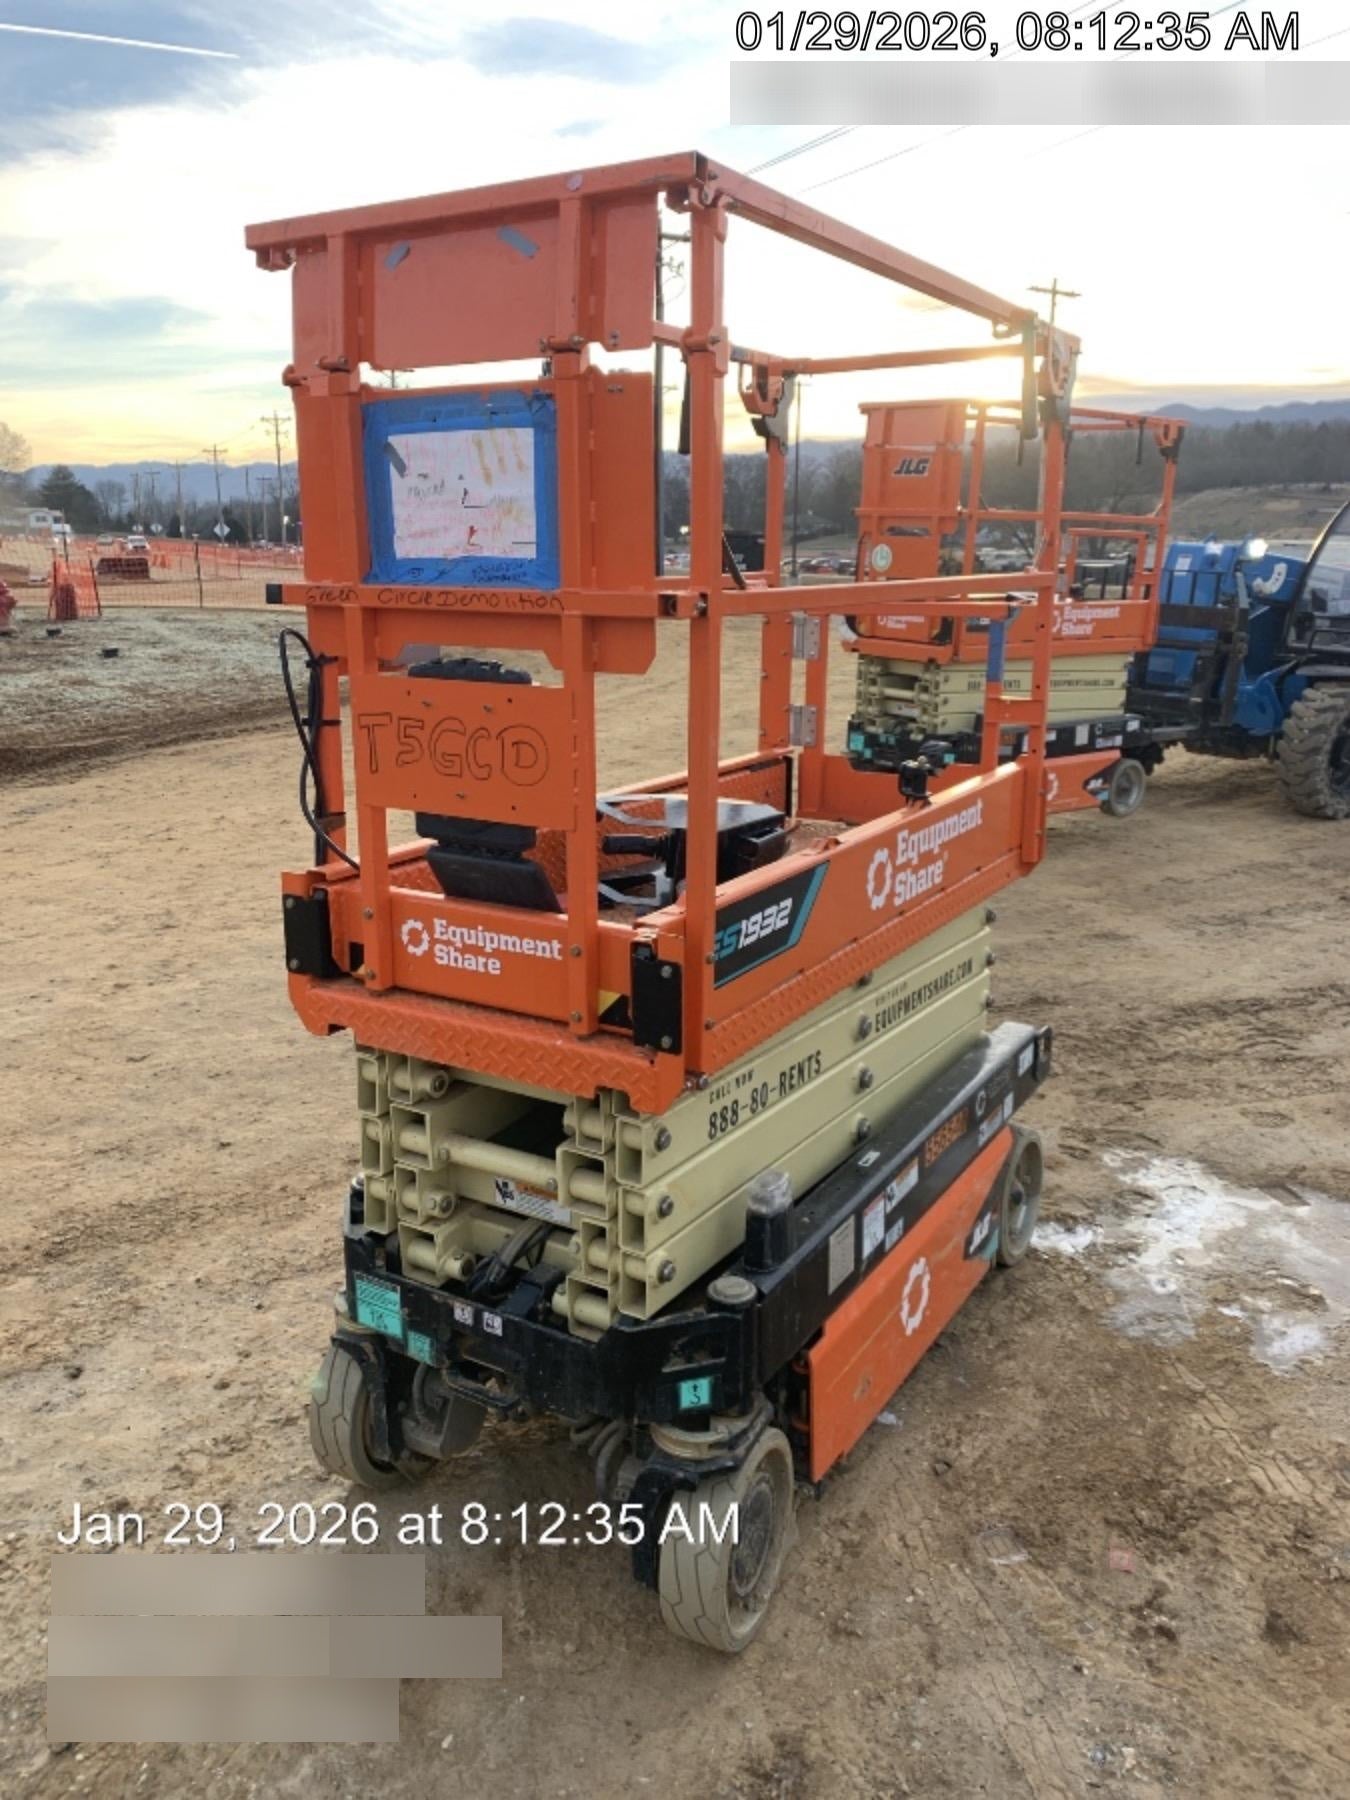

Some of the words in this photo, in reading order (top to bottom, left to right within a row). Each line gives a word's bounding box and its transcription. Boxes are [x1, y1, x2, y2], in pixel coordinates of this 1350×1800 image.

[892, 457, 931, 477] JLG
[894, 797, 982, 867] Equipment
[893, 858, 944, 907] Share
[432, 917, 563, 960] Equipment
[433, 943, 502, 975] Share
[707, 1048, 823, 1141] 888-80-RENTS
